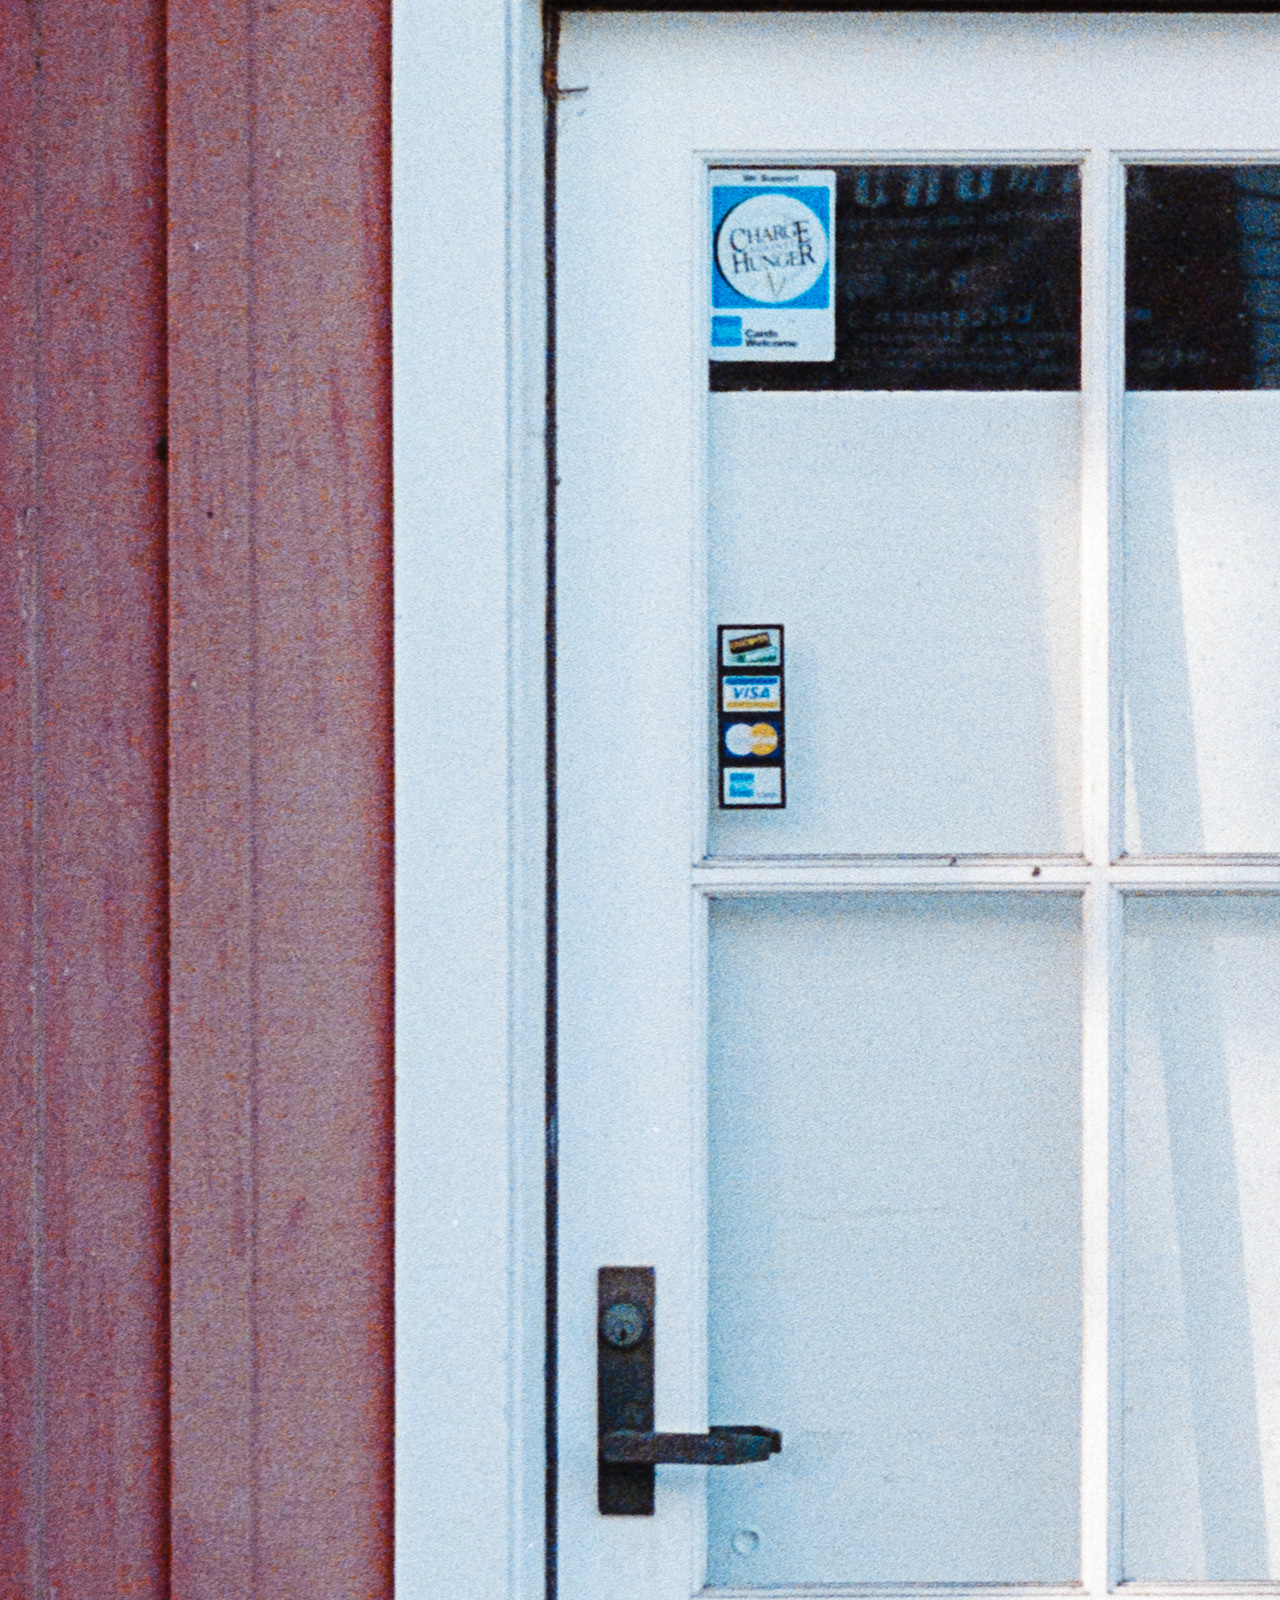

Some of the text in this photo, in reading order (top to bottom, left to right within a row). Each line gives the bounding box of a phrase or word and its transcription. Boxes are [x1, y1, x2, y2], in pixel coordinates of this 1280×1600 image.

[729, 220, 811, 253] CHARGE
[732, 246, 816, 275] HUNGER
[733, 686, 771, 699] VISA
